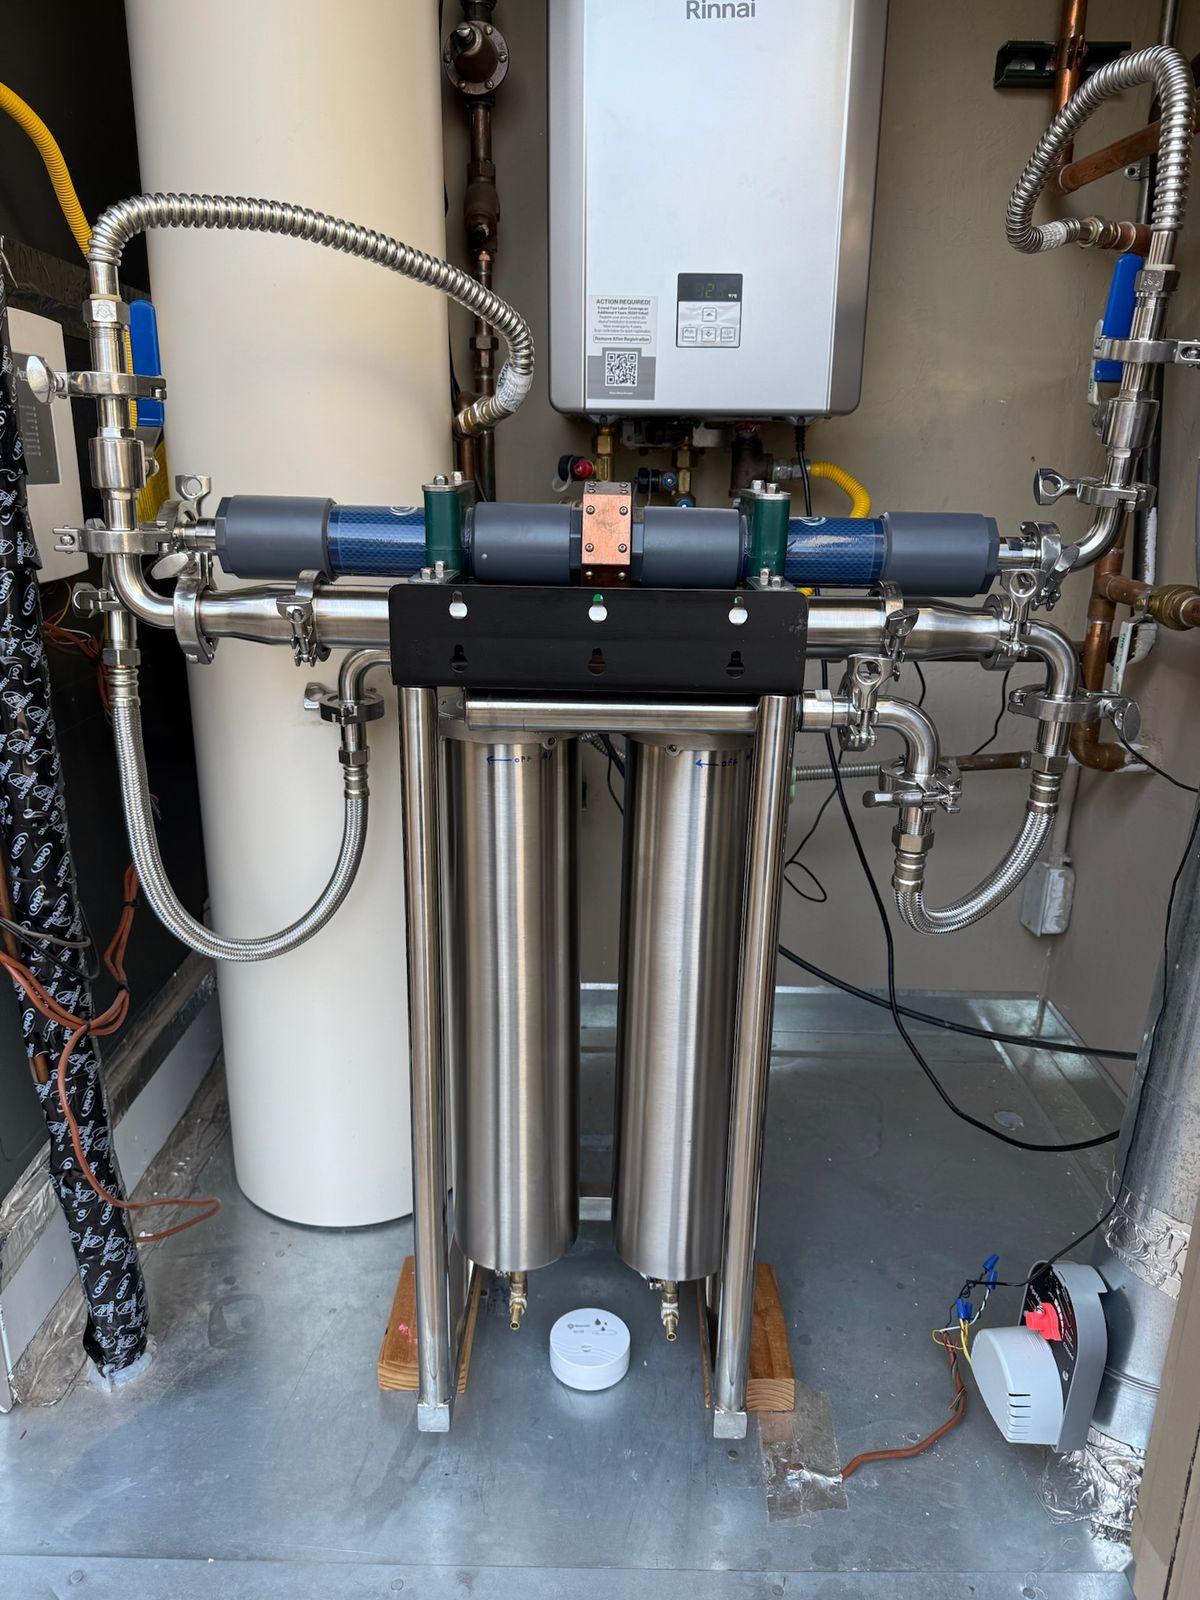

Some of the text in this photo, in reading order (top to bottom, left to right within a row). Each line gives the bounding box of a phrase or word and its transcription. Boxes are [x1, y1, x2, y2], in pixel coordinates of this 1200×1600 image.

[687, 0, 755, 19] Rinnai
[24, 588, 36, 610] Orbit
[12, 836, 26, 855] Orbit
[33, 847, 50, 869] Orbit
[57, 856, 70, 877] Orbit
[30, 889, 44, 912] Orbit
[52, 899, 67, 919] Orbit
[23, 1012, 34, 1032] Orbit
[82, 1090, 95, 1111] Orbit
[94, 1275, 109, 1294] Orbit
[116, 1280, 130, 1299] Orbit
